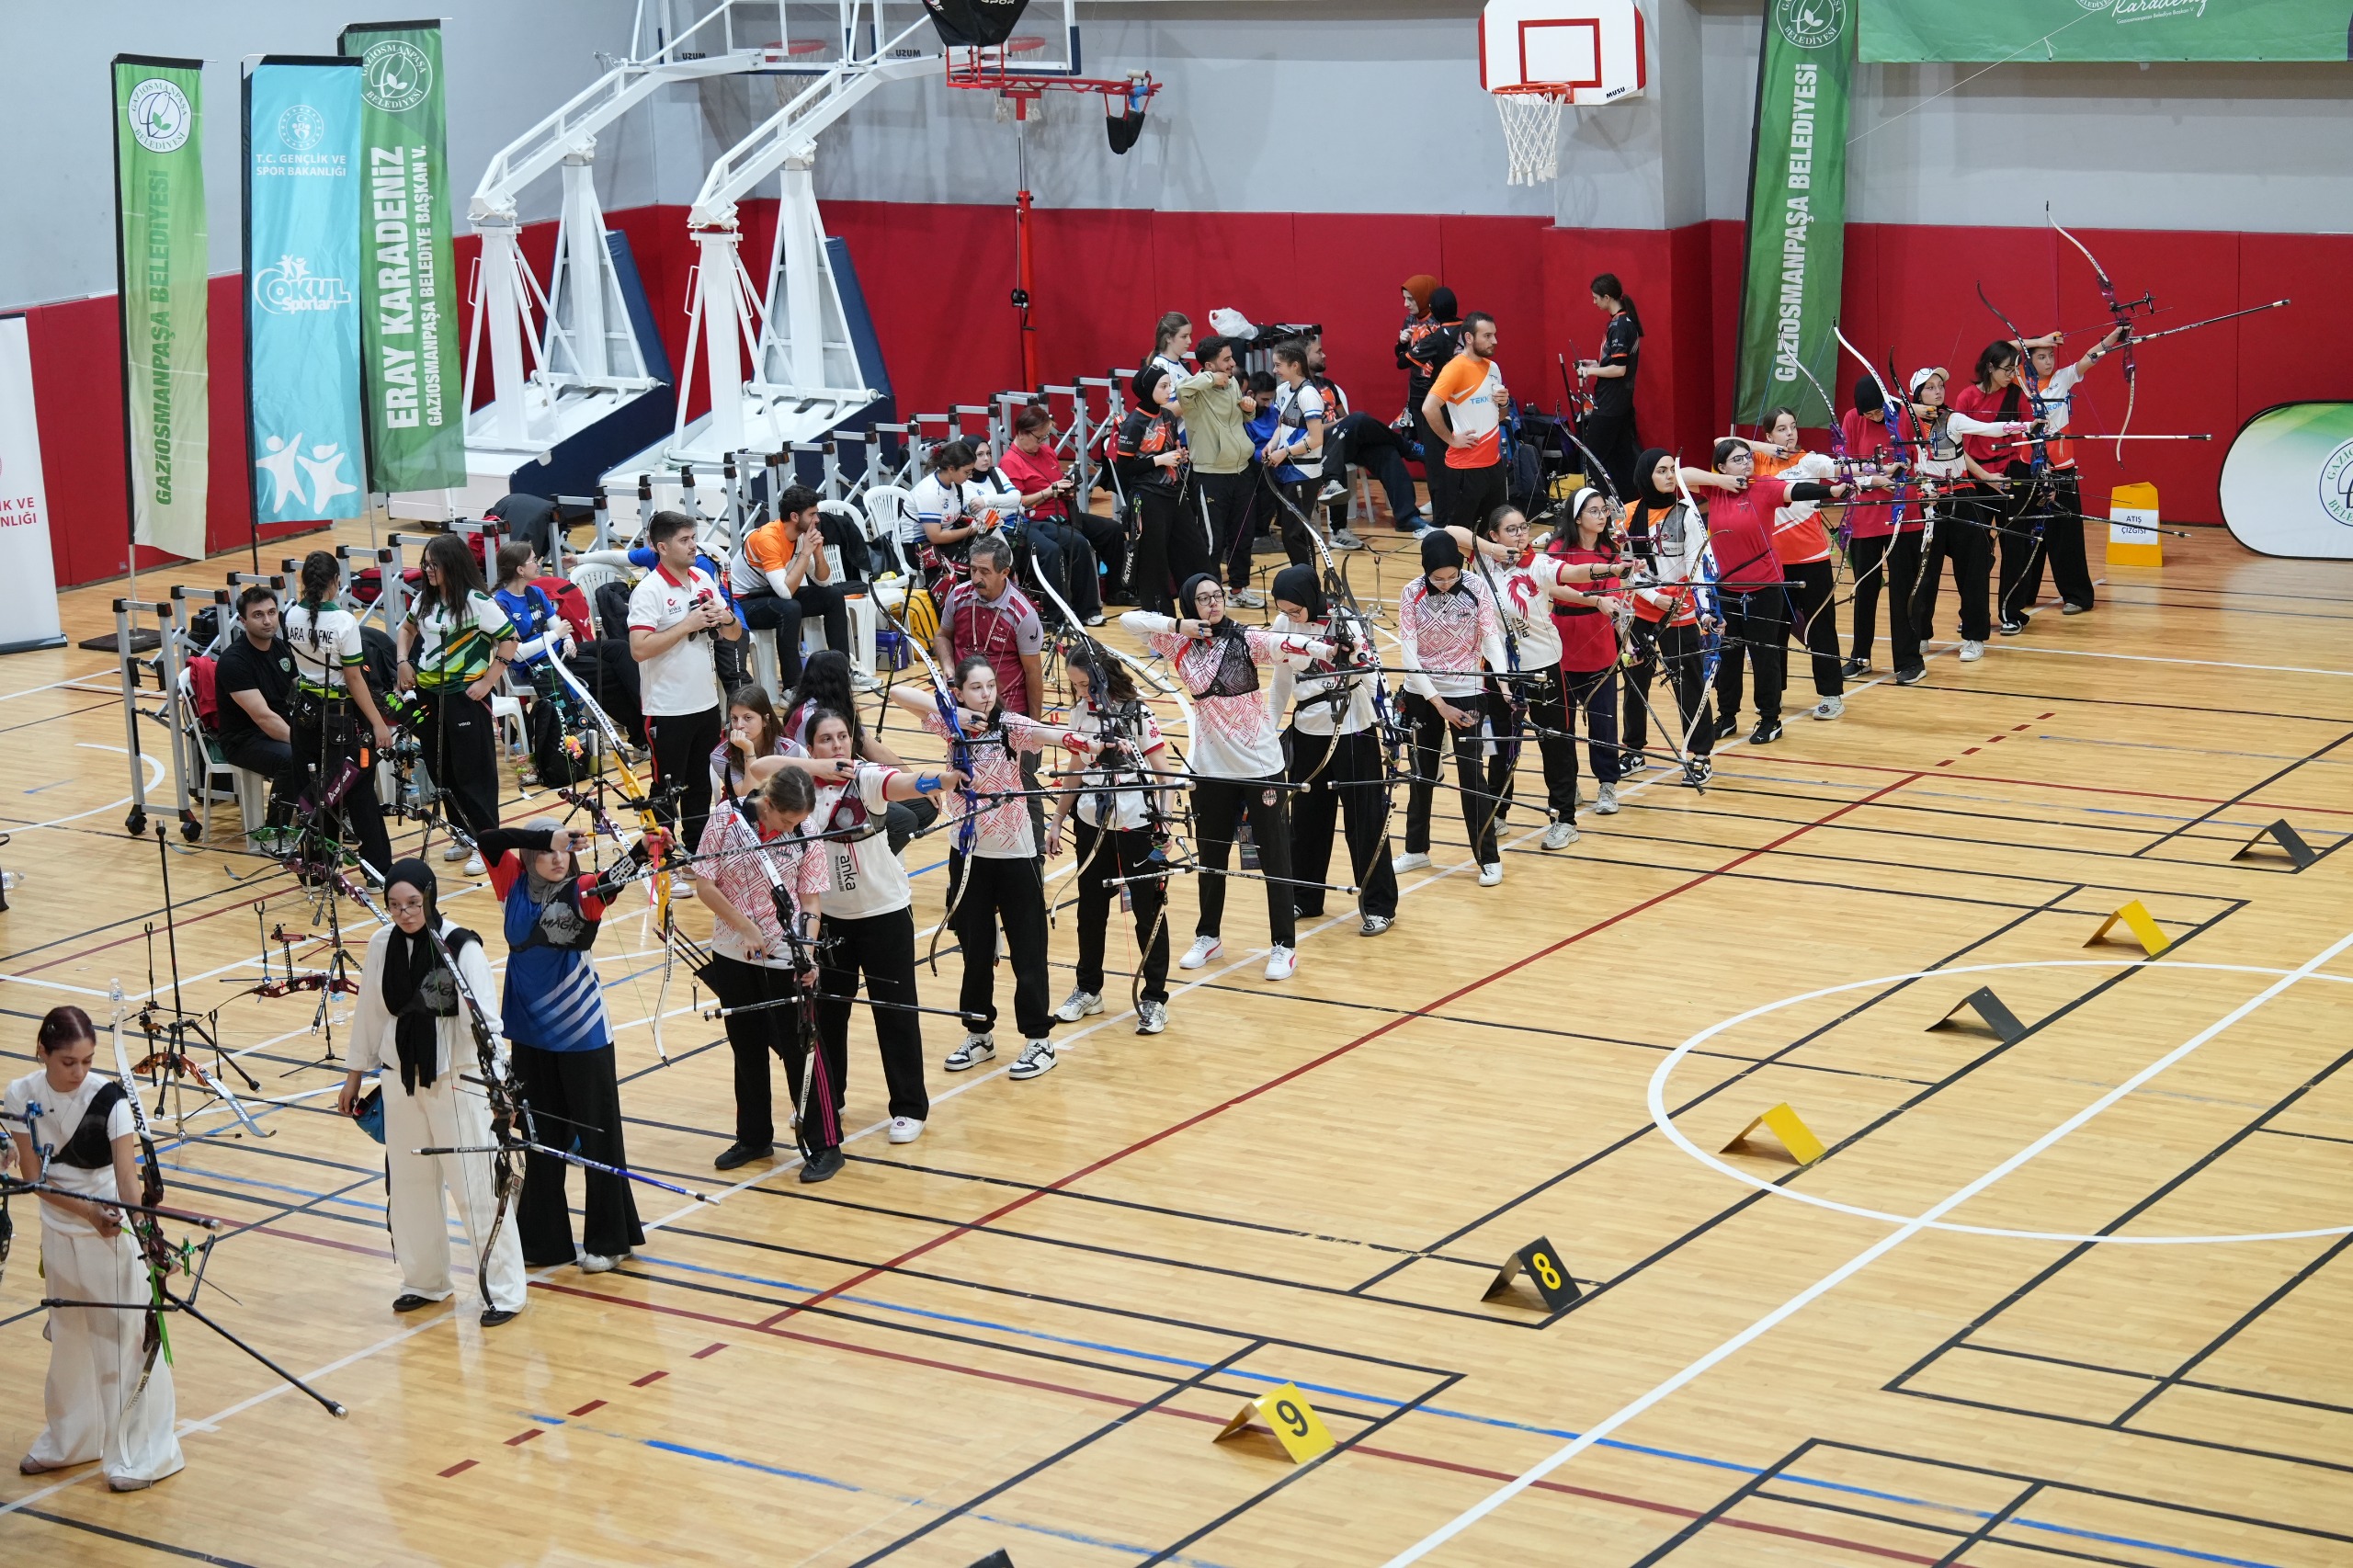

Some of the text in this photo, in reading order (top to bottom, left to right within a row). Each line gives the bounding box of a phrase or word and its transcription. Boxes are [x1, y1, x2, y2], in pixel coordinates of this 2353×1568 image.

[1784, 26, 1837, 45] BELEDİYESİ
[131, 82, 188, 116] GAZİOSMANPAŞA
[367, 88, 423, 108] BELEDİYESİ
[1606, 86, 1625, 98] MUSU
[1788, 63, 1818, 189] BELEDİYESİ
[135, 128, 186, 150] BELEDİYESİ
[256, 153, 346, 166] T.C. GENÇLİK VE
[256, 165, 347, 176] SPOR BAKANLIĞI
[267, 278, 351, 304] OKUL
[370, 146, 420, 428] ERAY KARADENİZ
[411, 145, 443, 426] GAZİOSMANPAŞA BELEDİYE BAŞKAN V.
[148, 169, 176, 506] GAZİOSMANPAŞA BELEDİYESİ
[17, 497, 35, 509] VE
[2126, 516, 2142, 525] ATIŞ
[309, 629, 334, 644] DFNE
[840, 855, 857, 891] anka
[369, 903, 391, 924] HOYT
[122, 1074, 146, 1131] WIAWIS
[231, 1100, 249, 1122] RAPTOR
[1532, 1252, 1562, 1290] 8
[1276, 1400, 1308, 1437] 9
